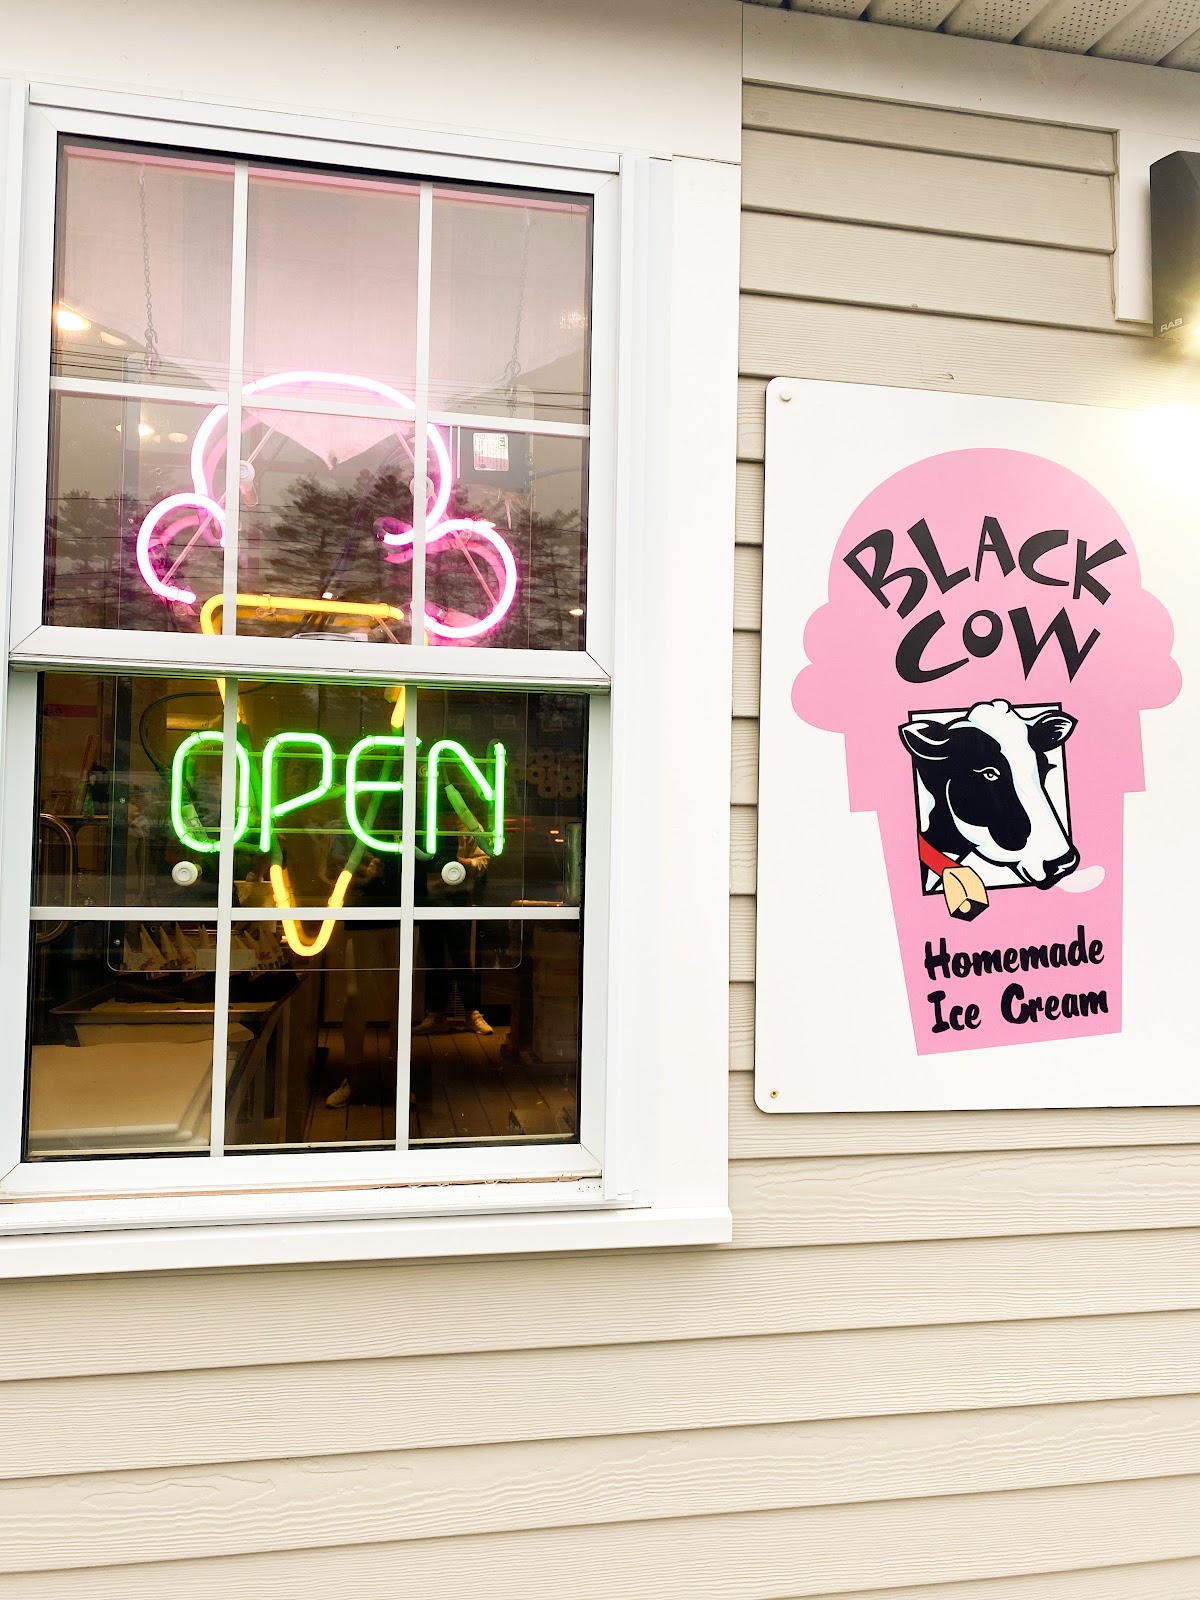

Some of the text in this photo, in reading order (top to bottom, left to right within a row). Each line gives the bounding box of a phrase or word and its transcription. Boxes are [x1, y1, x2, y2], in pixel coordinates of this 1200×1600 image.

[1160, 318, 1182, 332] RAB
[843, 515, 1127, 619] BLACK
[895, 606, 1100, 684] COW
[171, 730, 504, 856] OPEN
[924, 924, 1105, 980] Homemade
[927, 983, 1108, 1034] Ice Cream
